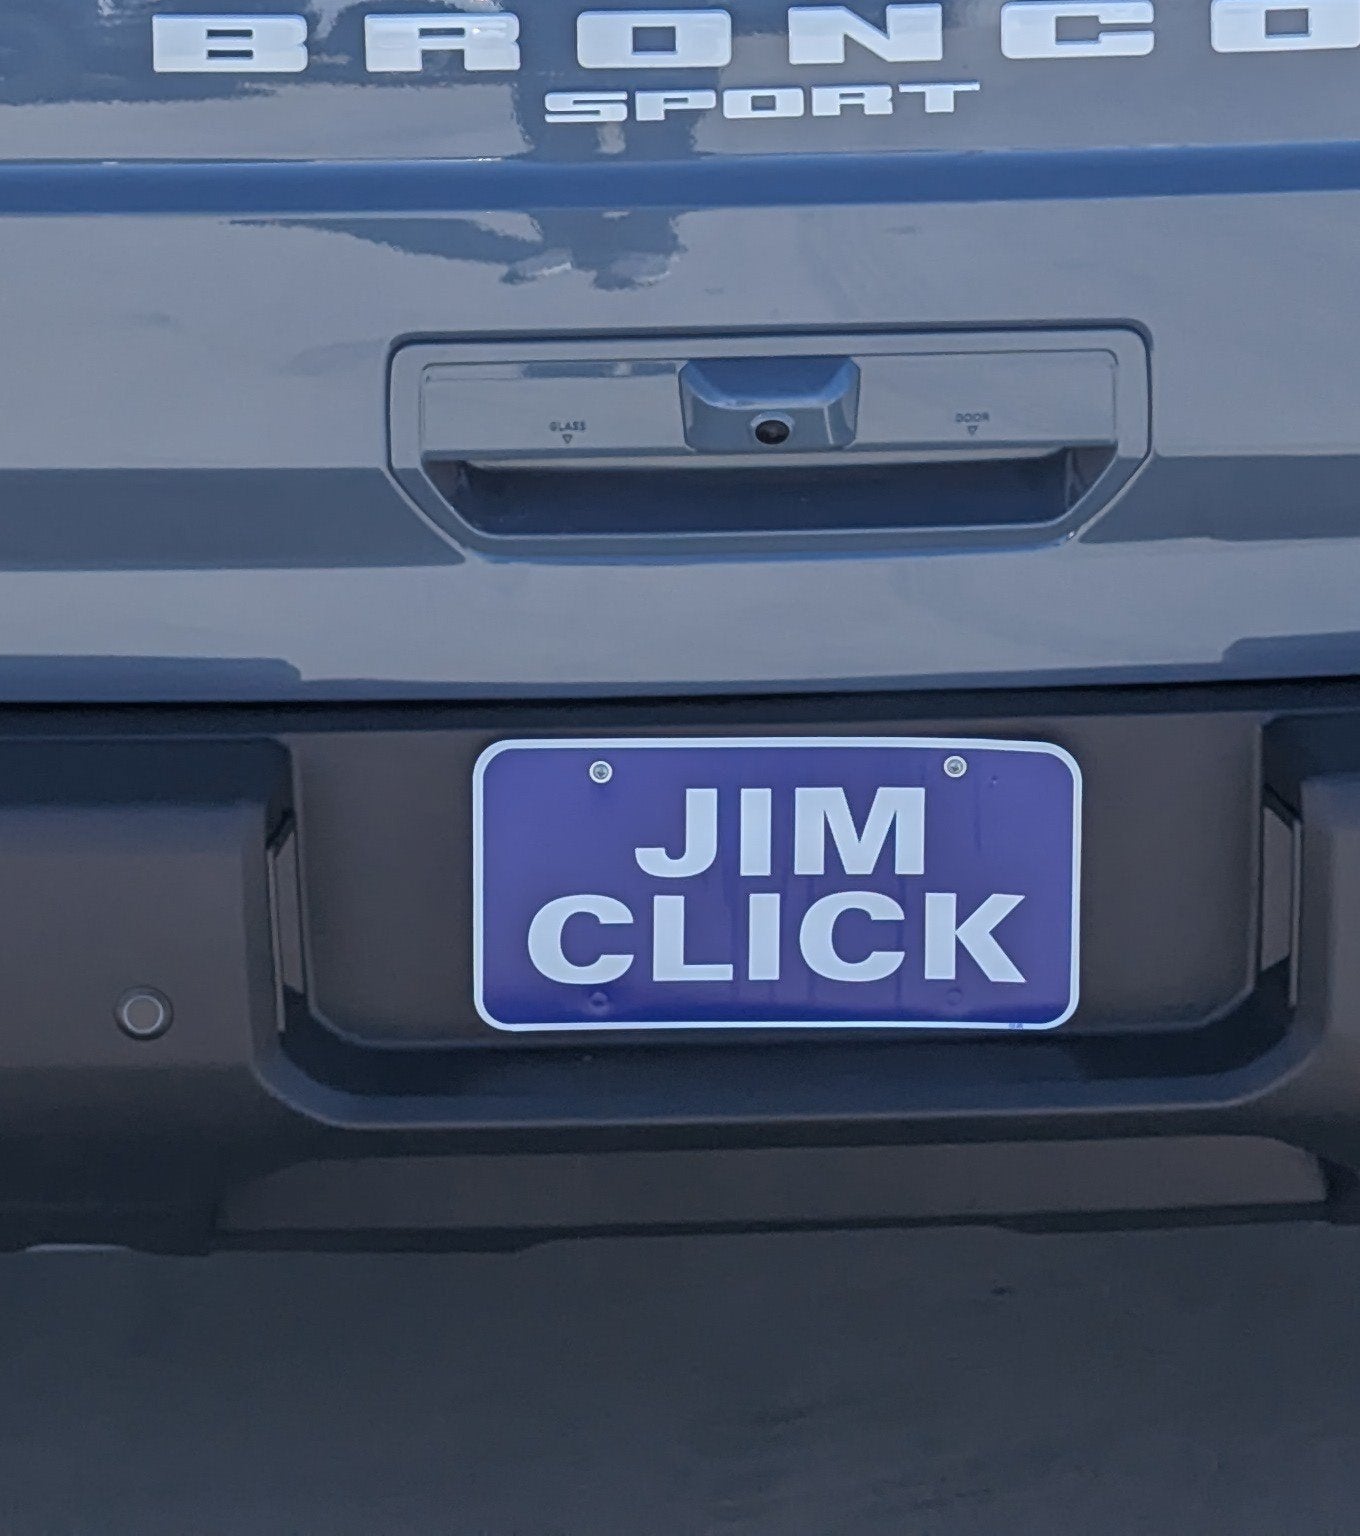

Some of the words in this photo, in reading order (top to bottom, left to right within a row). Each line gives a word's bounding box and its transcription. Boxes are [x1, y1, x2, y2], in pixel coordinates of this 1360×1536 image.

[544, 80, 981, 124] SPORT
[549, 421, 586, 431] GLASS
[955, 412, 990, 423] DOOR
[635, 786, 926, 878] JIM
[527, 891, 1027, 985] CLICK
